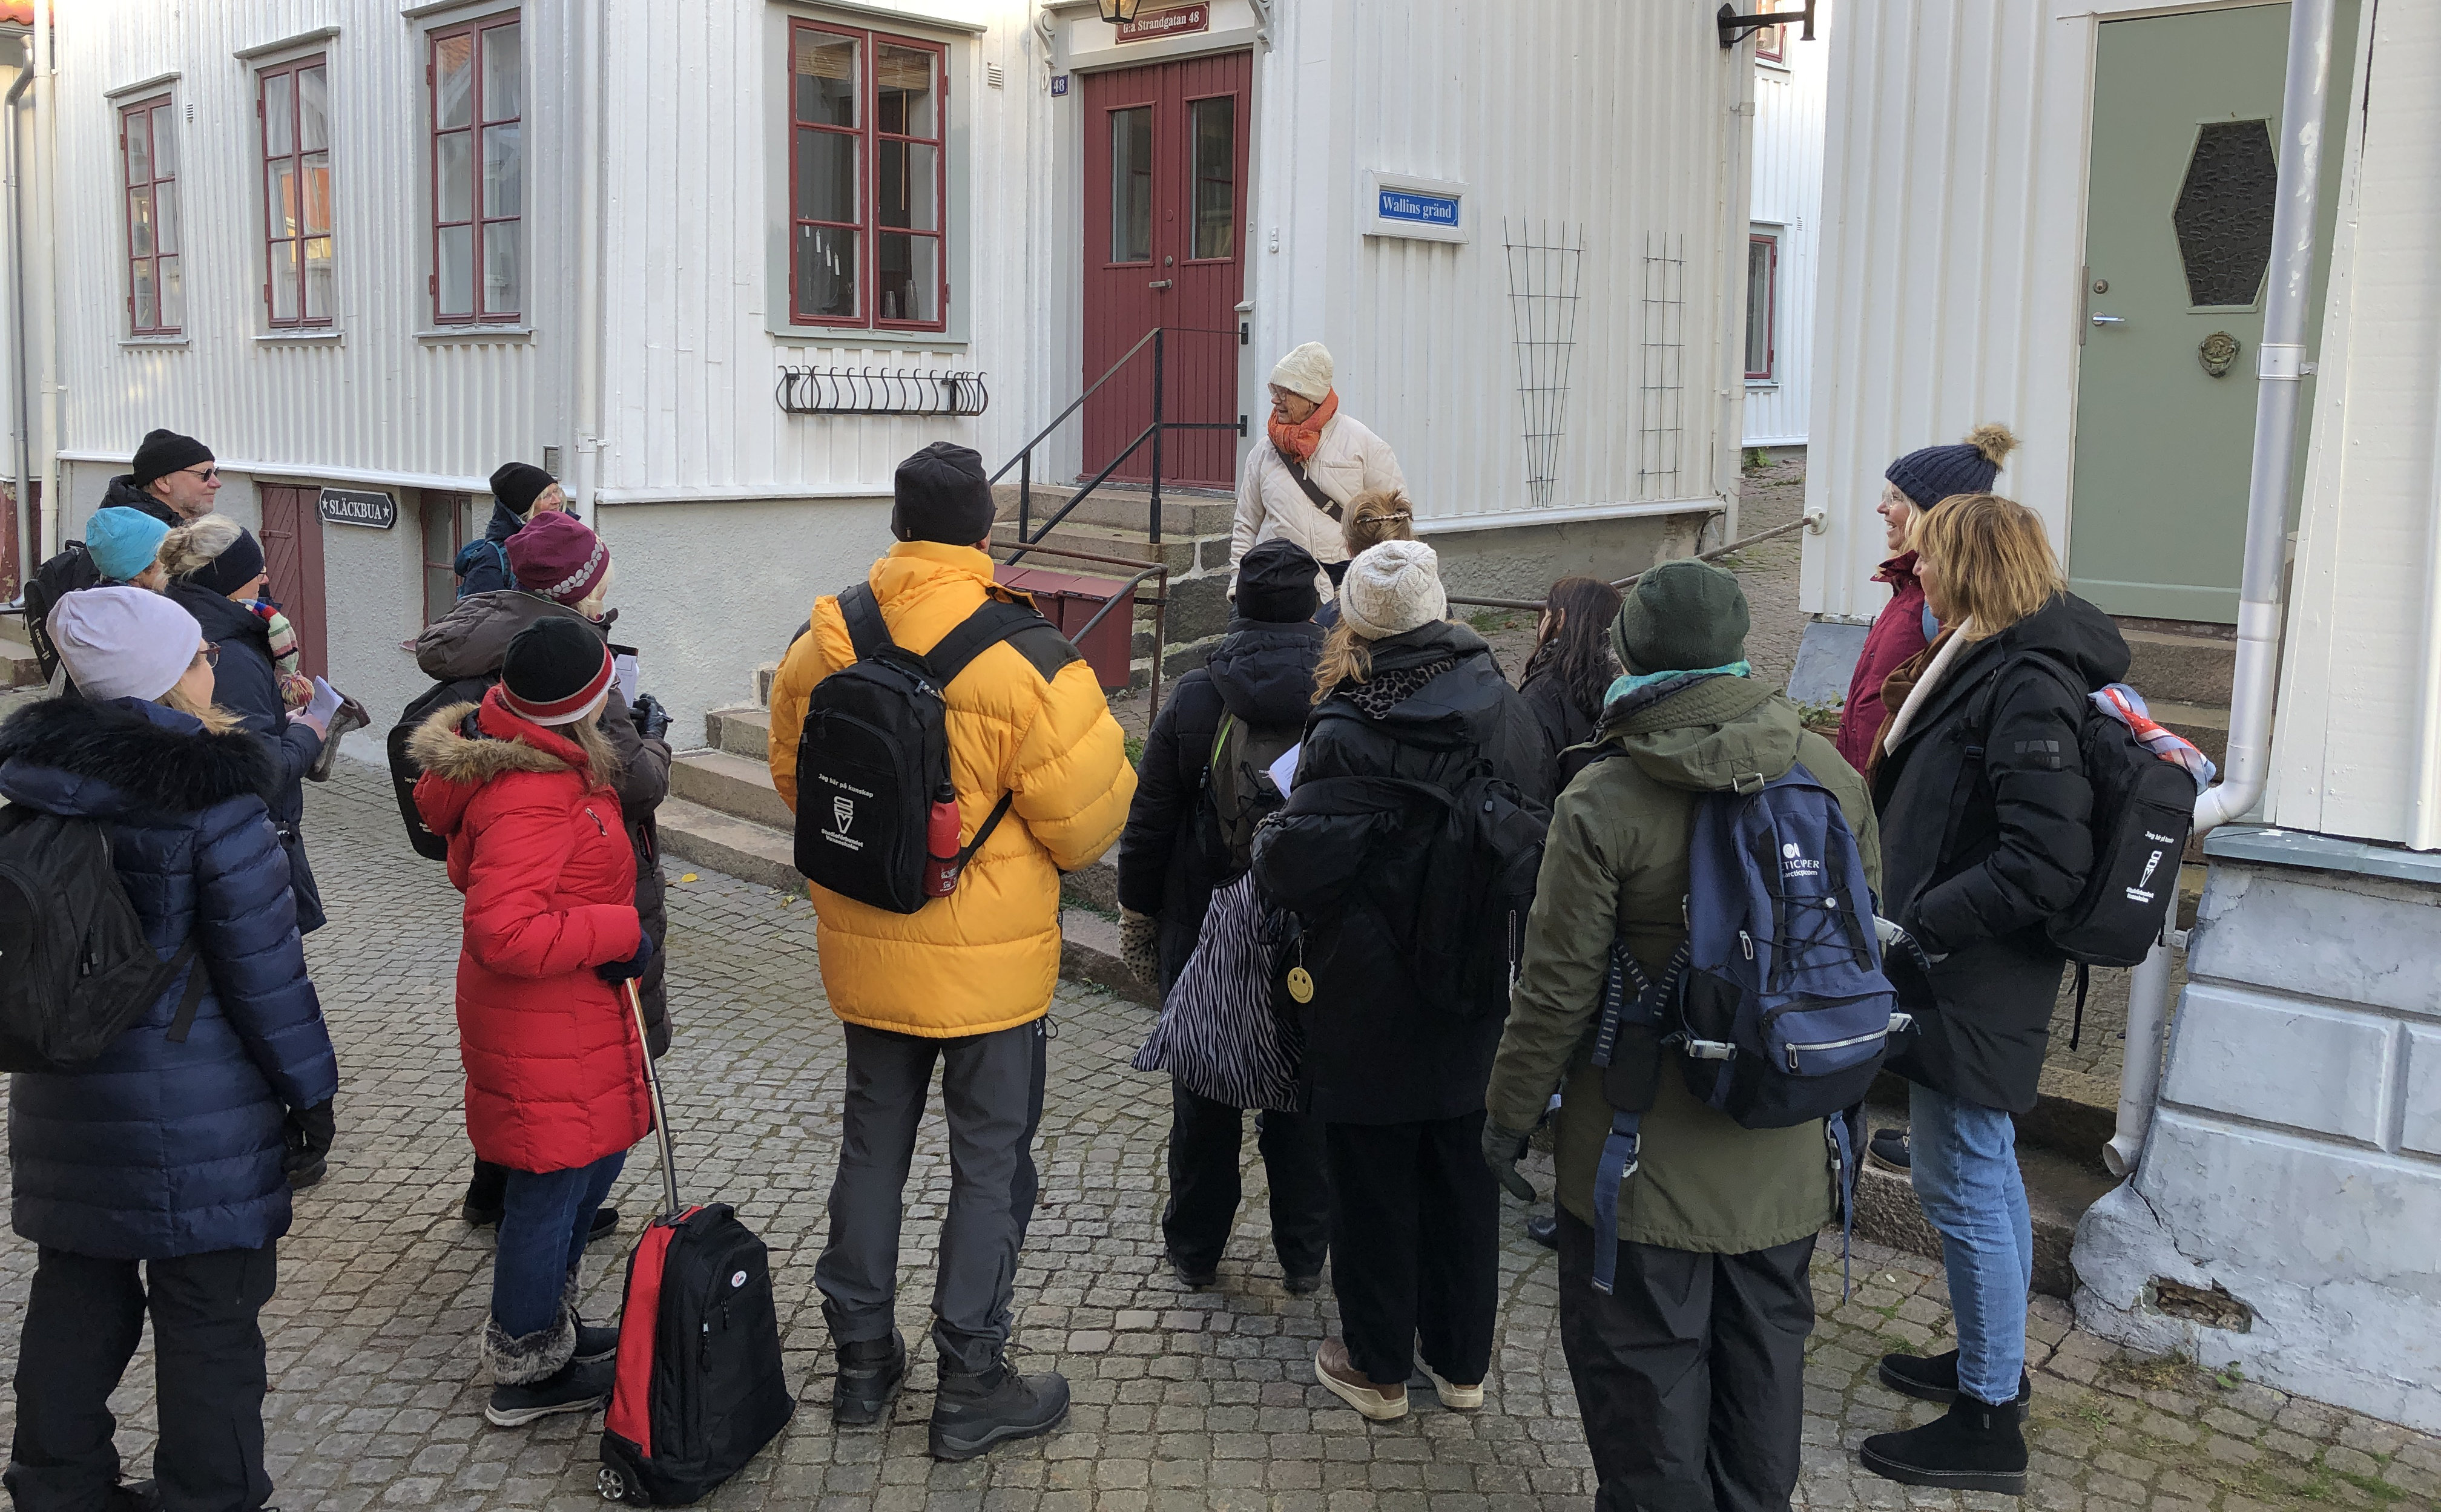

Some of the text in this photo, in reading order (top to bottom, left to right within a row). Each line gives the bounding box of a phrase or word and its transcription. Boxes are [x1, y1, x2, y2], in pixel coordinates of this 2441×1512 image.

[1138, 15, 1187, 31] Strandgatan
[1188, 11, 1199, 23] 48
[1053, 79, 1065, 93] 48
[1383, 196, 1452, 219] Wallins gränd
[329, 497, 383, 520] SLÄCKBUA
[819, 773, 829, 783] Jag
[829, 777, 839, 786] bär
[848, 784, 874, 798] kunskap
